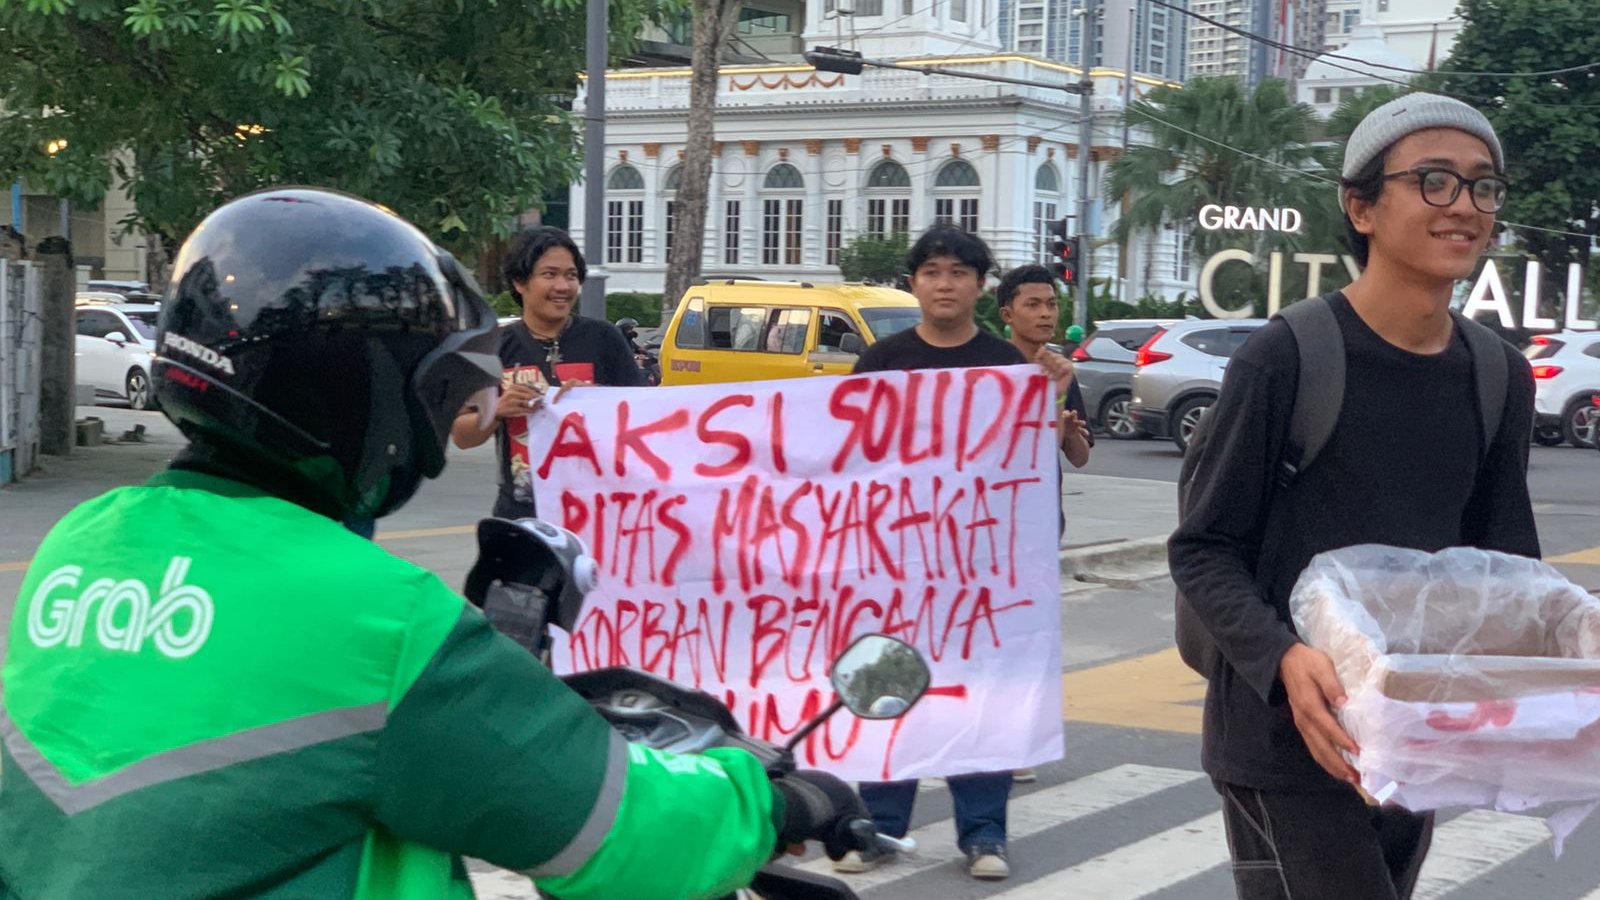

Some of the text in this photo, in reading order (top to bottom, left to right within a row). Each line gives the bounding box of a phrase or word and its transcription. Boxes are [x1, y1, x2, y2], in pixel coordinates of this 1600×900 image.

[1198, 203, 1302, 233] GRAND
[1199, 248, 1598, 329] CIT ALL
[164, 331, 235, 375] HONDA
[536, 391, 786, 482] AKSI
[713, 475, 1041, 601] MASYARAKAT
[27, 555, 215, 659] Grab
[569, 597, 735, 690] KORBAN
